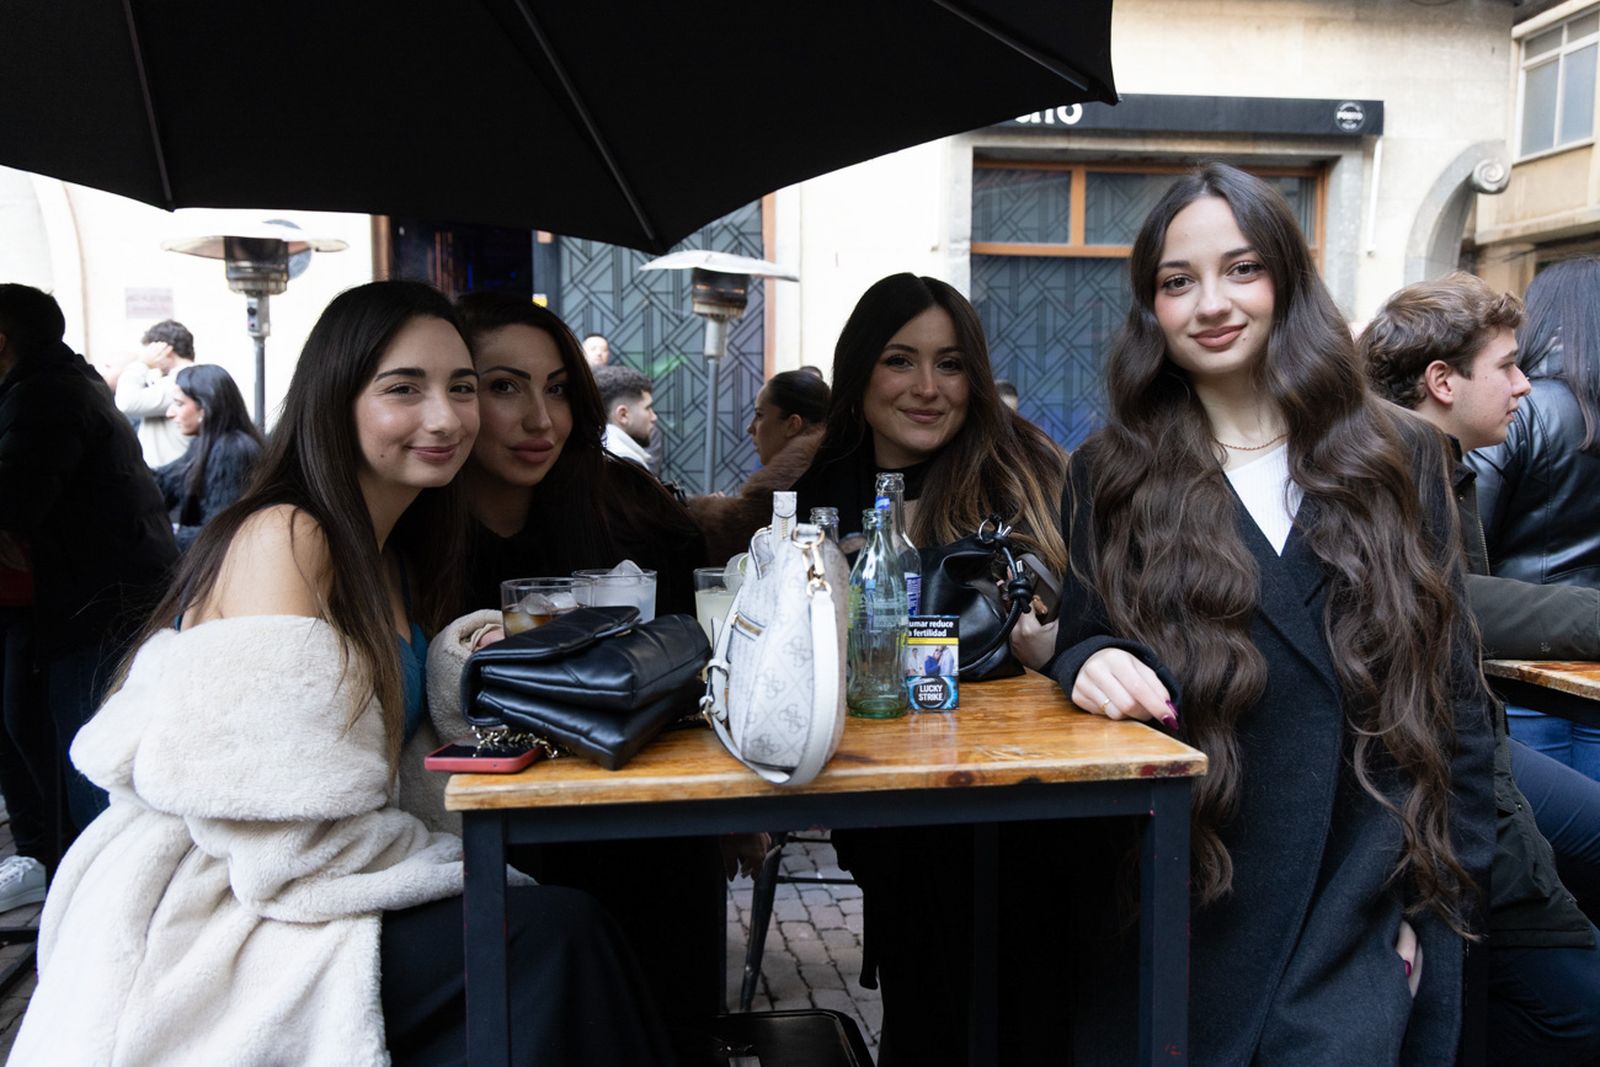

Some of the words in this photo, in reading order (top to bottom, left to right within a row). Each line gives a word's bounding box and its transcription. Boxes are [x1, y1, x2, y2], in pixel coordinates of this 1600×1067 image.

[929, 619, 954, 628] reduce
[913, 628, 947, 637] fertilidad
[919, 684, 943, 693] LUCKY
[918, 693, 944, 701] STRIKE
